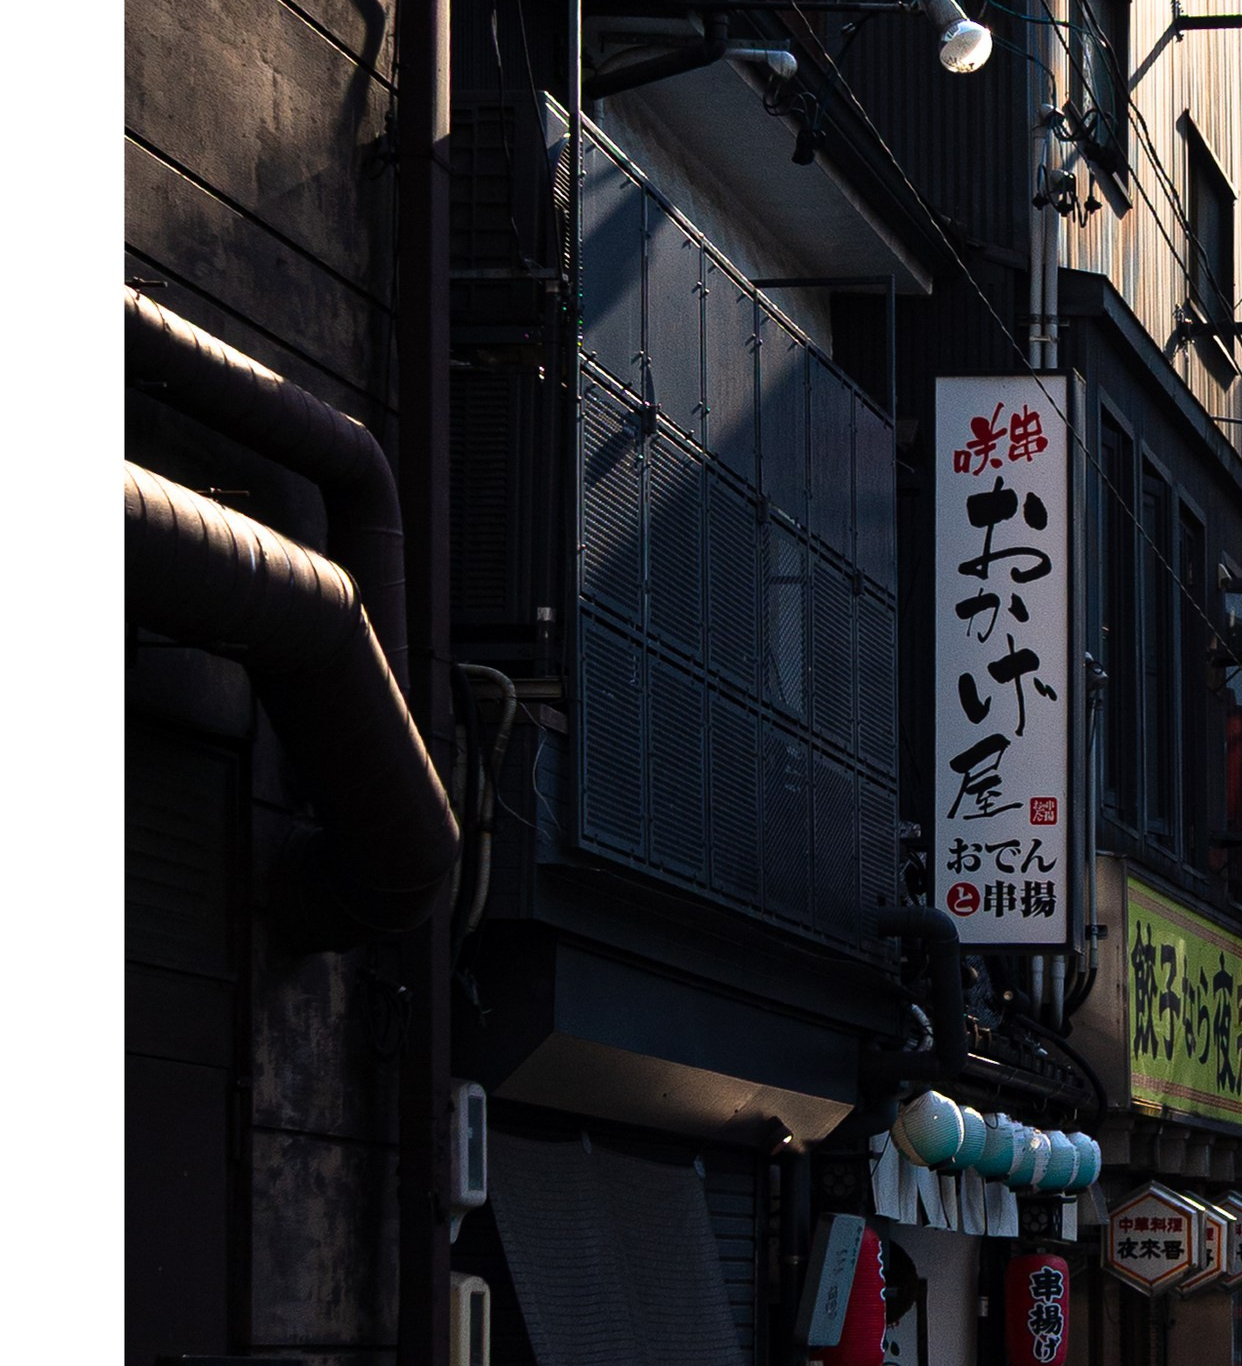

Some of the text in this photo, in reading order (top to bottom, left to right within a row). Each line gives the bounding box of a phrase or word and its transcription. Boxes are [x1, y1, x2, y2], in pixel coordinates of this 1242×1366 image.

[947, 476, 1058, 820] おかげ屋
[947, 838, 1057, 874] おでん
[946, 880, 1057, 919] と串揚
[1119, 1217, 1183, 1233] 中華料理
[1027, 1265, 1065, 1365] 串揚げ
